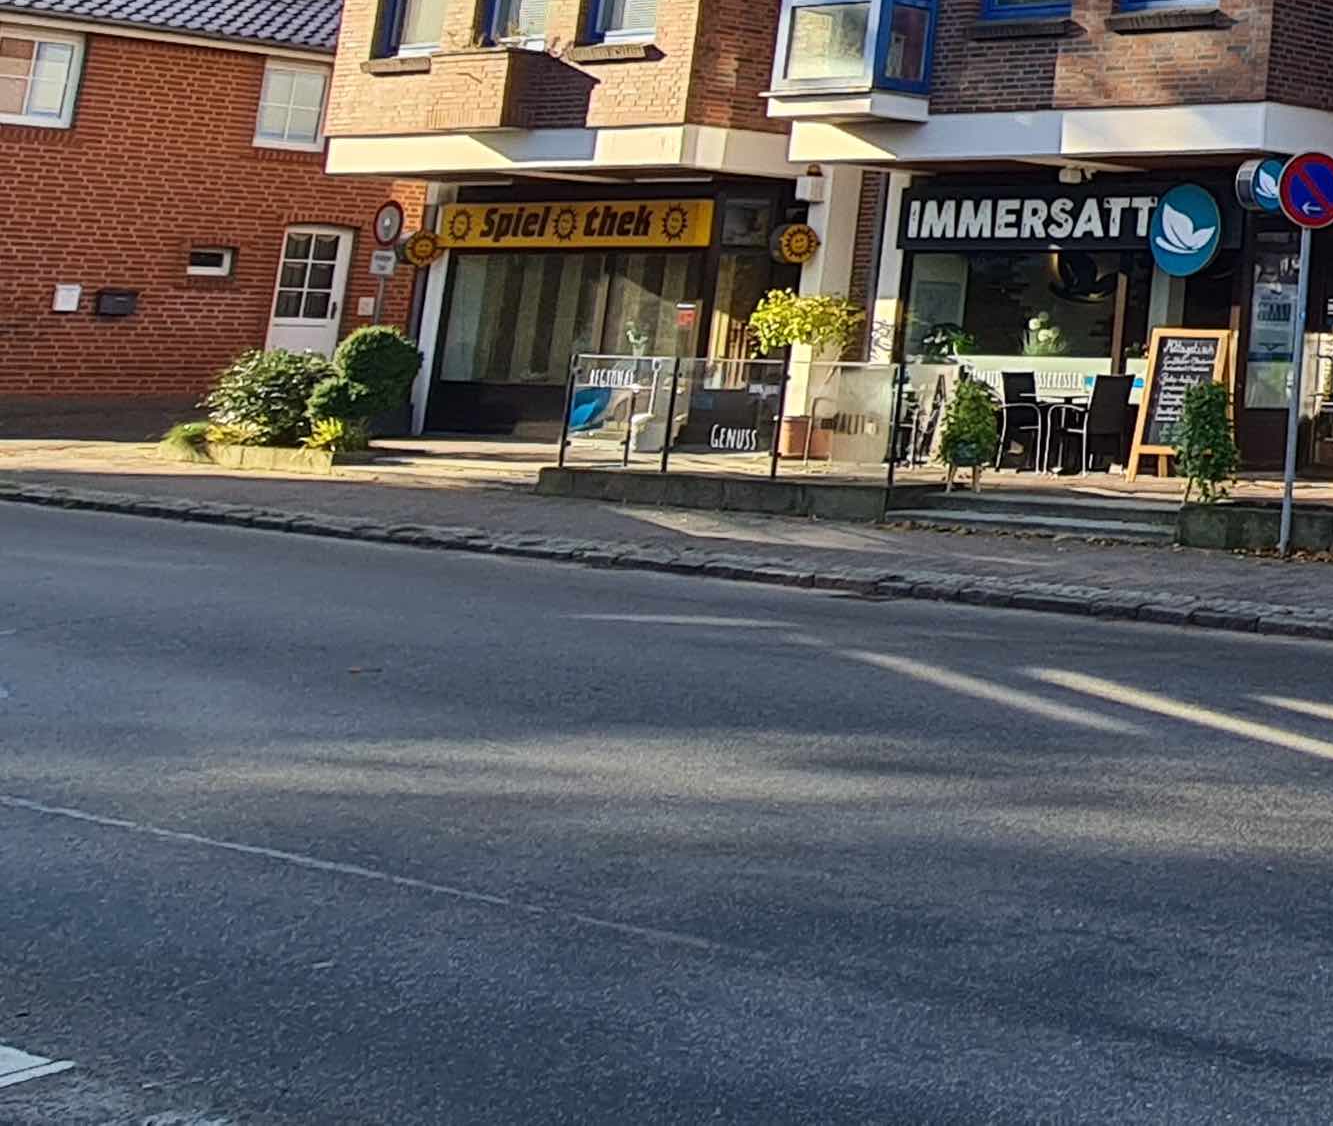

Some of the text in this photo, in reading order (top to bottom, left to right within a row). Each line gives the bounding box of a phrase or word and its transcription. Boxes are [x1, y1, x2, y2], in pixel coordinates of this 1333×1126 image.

[480, 205, 653, 242] Spiel thek
[906, 196, 1158, 239] IMMERSATT
